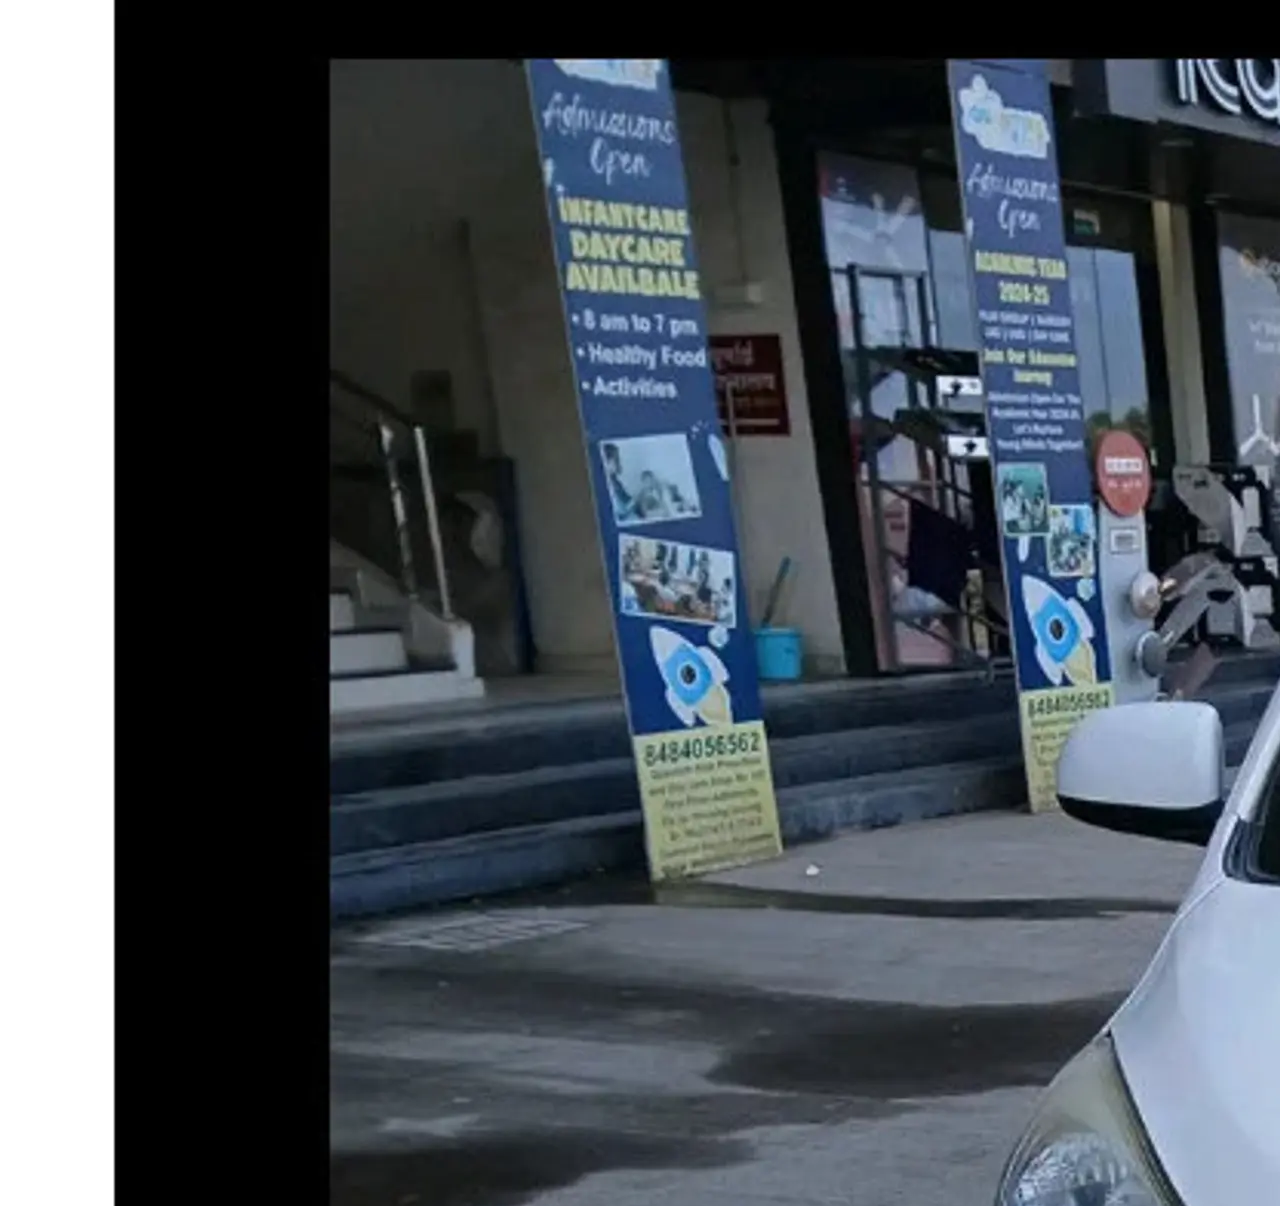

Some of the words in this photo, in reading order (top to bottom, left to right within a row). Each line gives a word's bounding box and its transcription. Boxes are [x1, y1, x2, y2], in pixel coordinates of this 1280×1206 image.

[542, 91, 676, 145] Admissions
[590, 136, 651, 185] Open
[569, 230, 686, 267] DAYCARE
[600, 315, 630, 332] am
[632, 314, 652, 333] to
[653, 313, 665, 333] 7
[669, 317, 700, 339] pm
[588, 342, 659, 371] Healthy
[661, 345, 709, 368] Food
[593, 375, 679, 400] Activities
[644, 730, 761, 768] 8484056562
